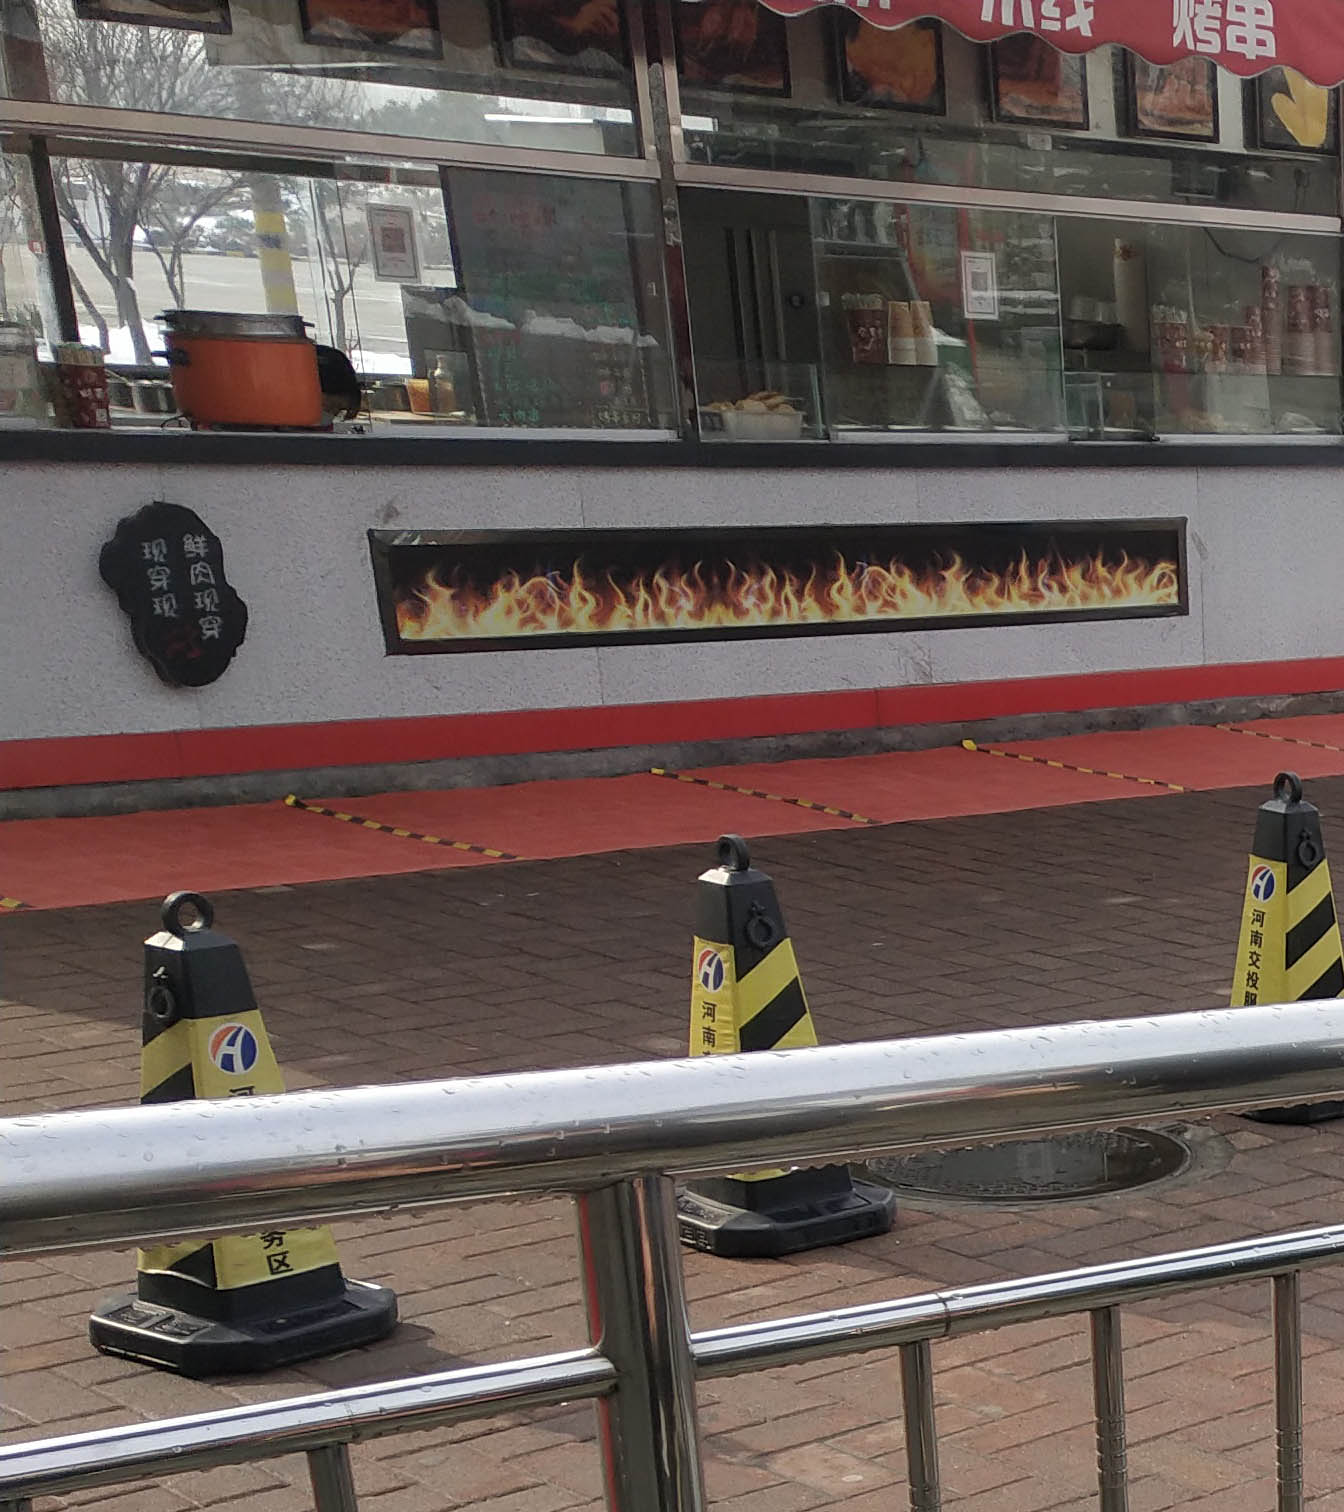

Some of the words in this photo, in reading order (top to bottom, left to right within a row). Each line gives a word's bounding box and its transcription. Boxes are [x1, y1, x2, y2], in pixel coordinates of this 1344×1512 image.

[1173, 0, 1277, 60] 烤串
[182, 533, 223, 640] 鲜肉现穿
[1244, 908, 1266, 1006] 河南交投服
[702, 1001, 717, 1055] 河南
